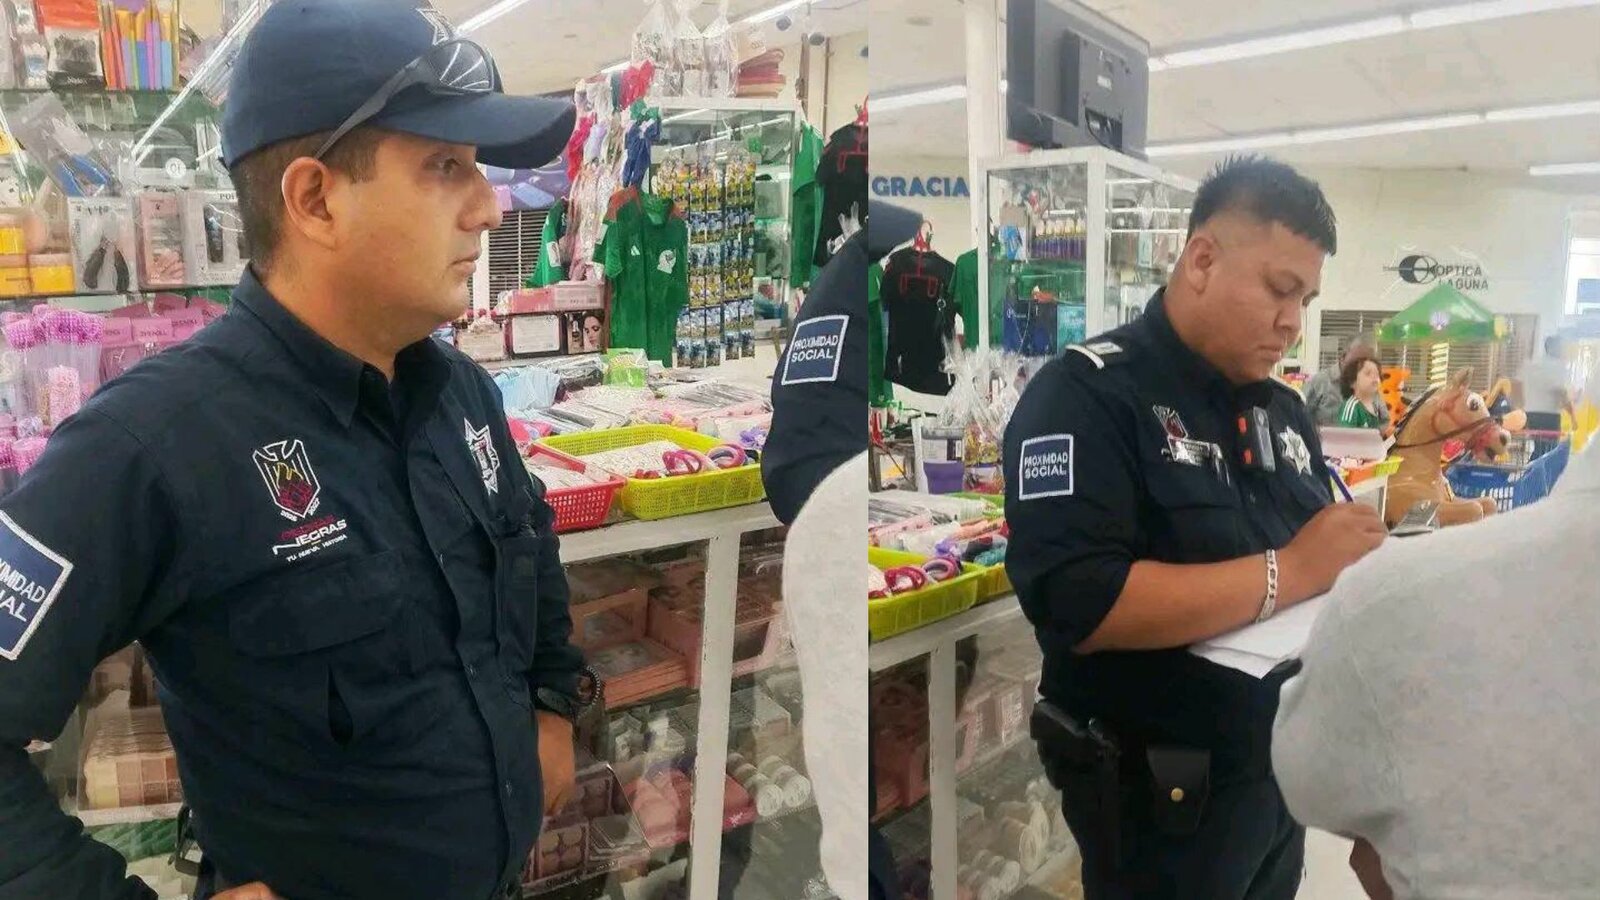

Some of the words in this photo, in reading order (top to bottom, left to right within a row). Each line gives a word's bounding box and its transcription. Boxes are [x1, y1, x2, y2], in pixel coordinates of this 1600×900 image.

[872, 176, 970, 197] GRACIA
[1437, 265, 1482, 277] OPTICA
[793, 335, 839, 351] PROXIMIDAD
[791, 348, 834, 363] SOCIAL
[1024, 464, 1067, 479] SOCIAL
[272, 519, 347, 555] NEGRAS
